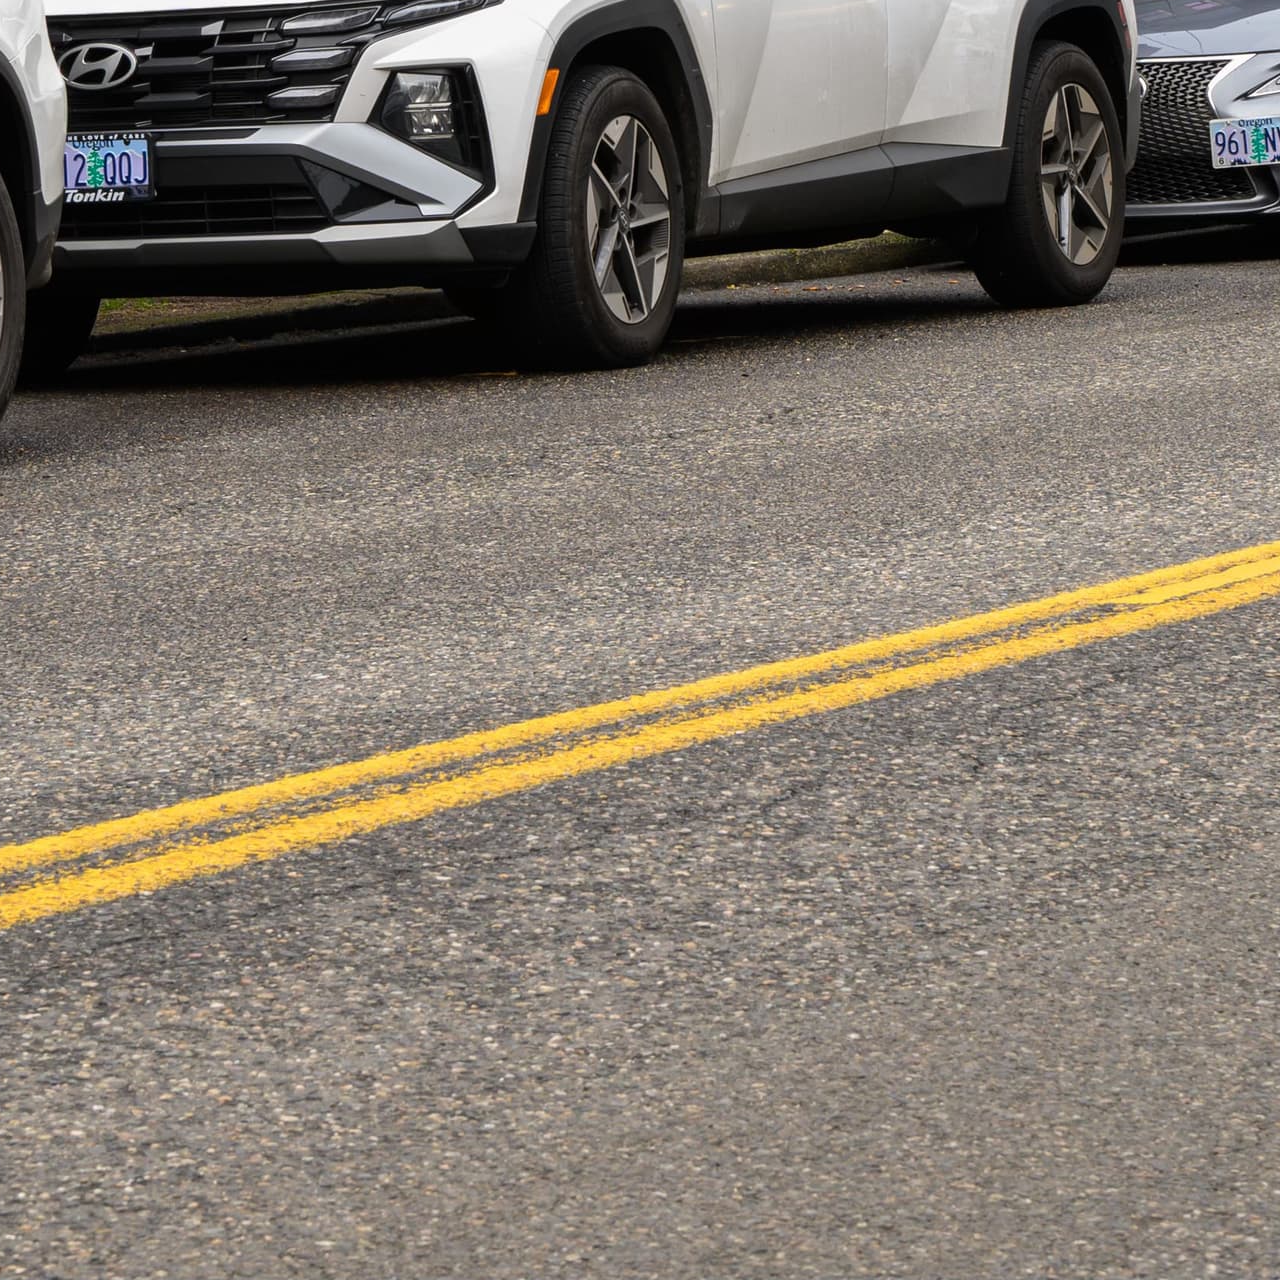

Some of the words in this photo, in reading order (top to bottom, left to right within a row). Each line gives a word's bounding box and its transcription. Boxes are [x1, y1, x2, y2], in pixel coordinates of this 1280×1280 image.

[1238, 117, 1273, 128] Oregon
[1215, 129, 1248, 156] 961
[104, 151, 147, 186] QQJ
[64, 189, 125, 203] Tonkin
